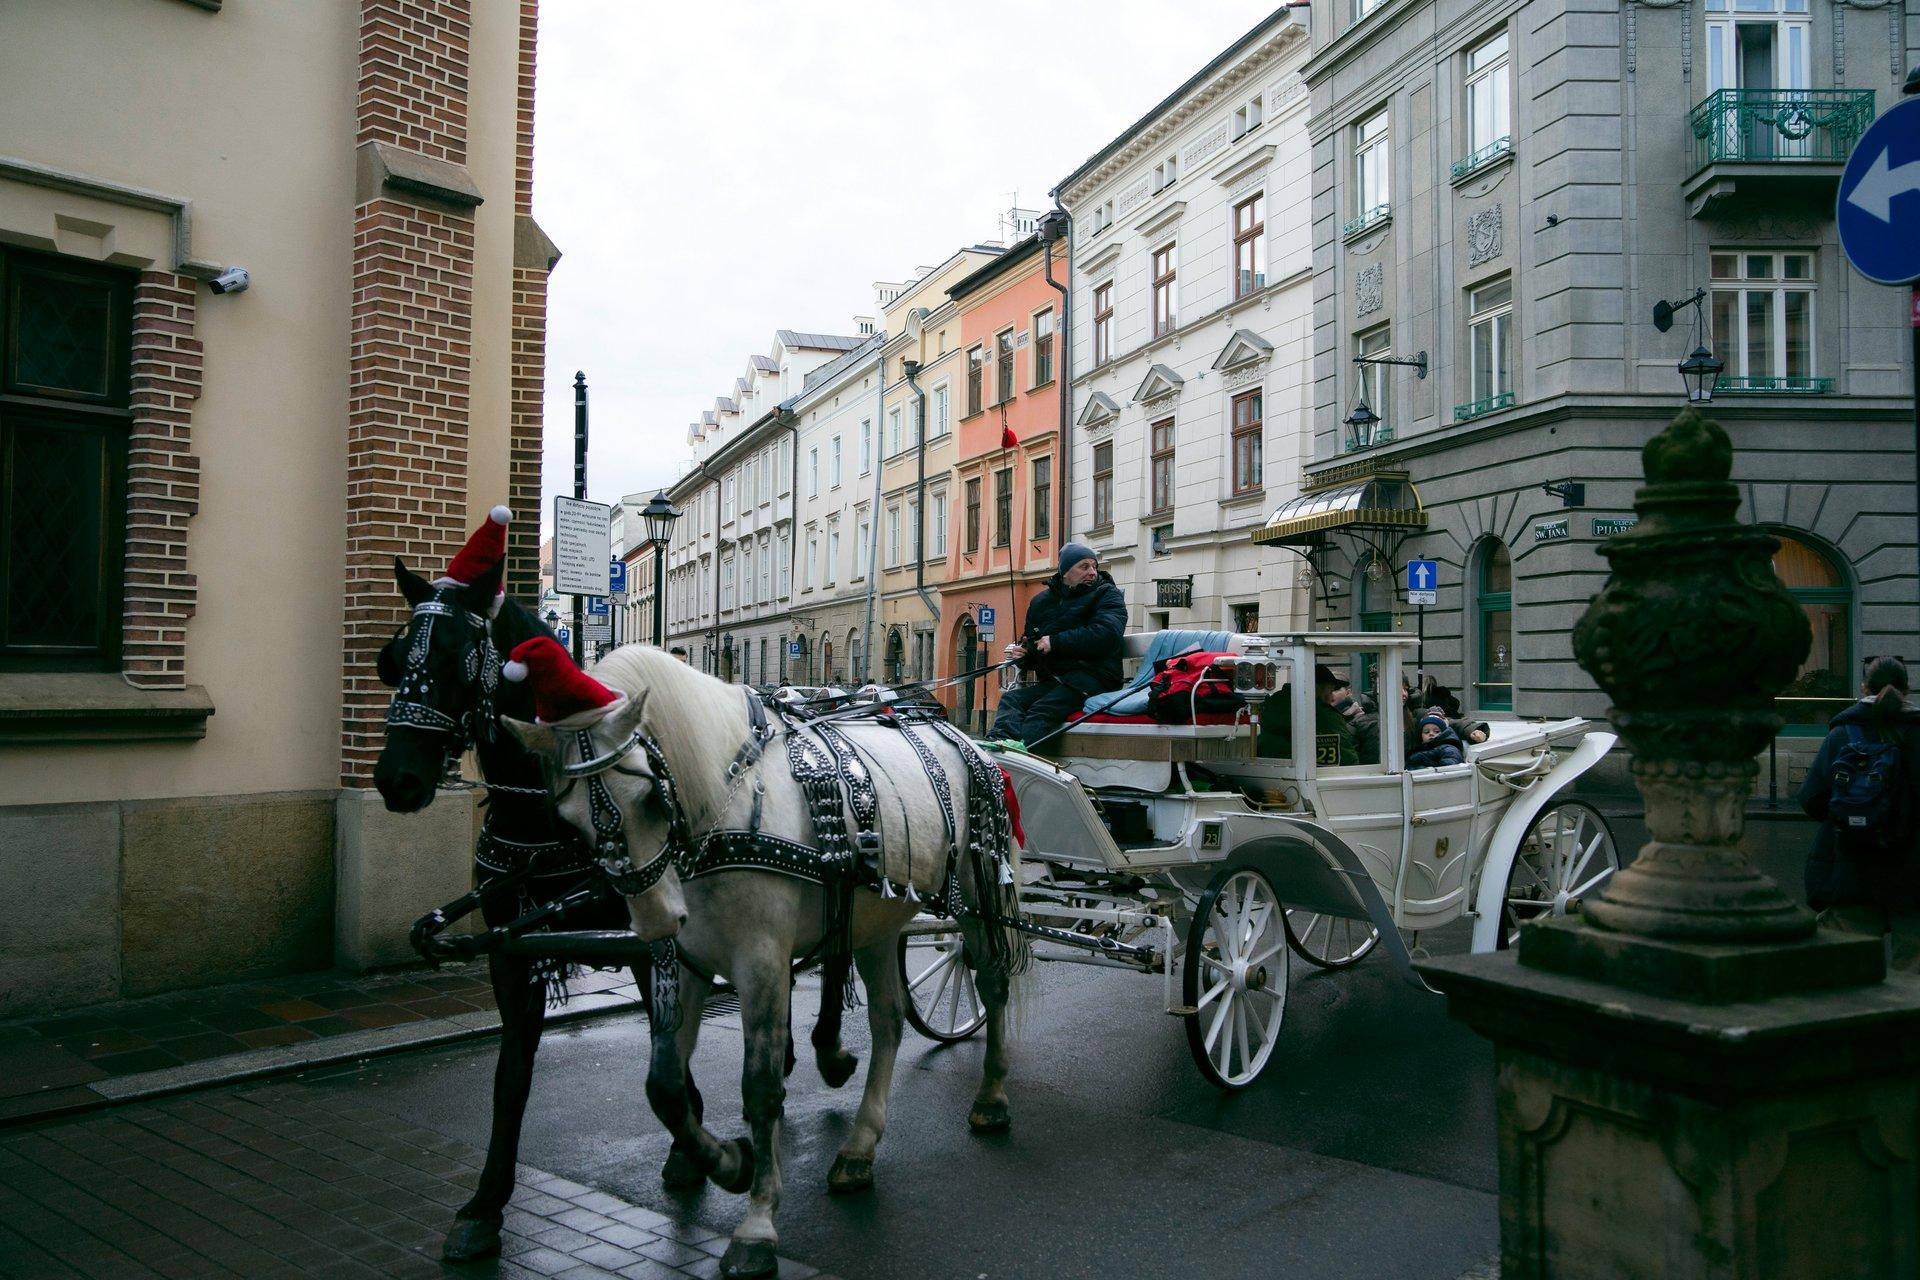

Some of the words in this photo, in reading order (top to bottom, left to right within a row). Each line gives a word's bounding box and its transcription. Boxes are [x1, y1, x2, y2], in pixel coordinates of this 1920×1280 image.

[1548, 528, 1567, 539] JANA
[1158, 584, 1190, 593] GOSSIP
[982, 610, 992, 623] P
[560, 630, 568, 638] P
[792, 643, 799, 653] P
[1317, 747, 1337, 764] 23
[1205, 833, 1218, 846] 23
